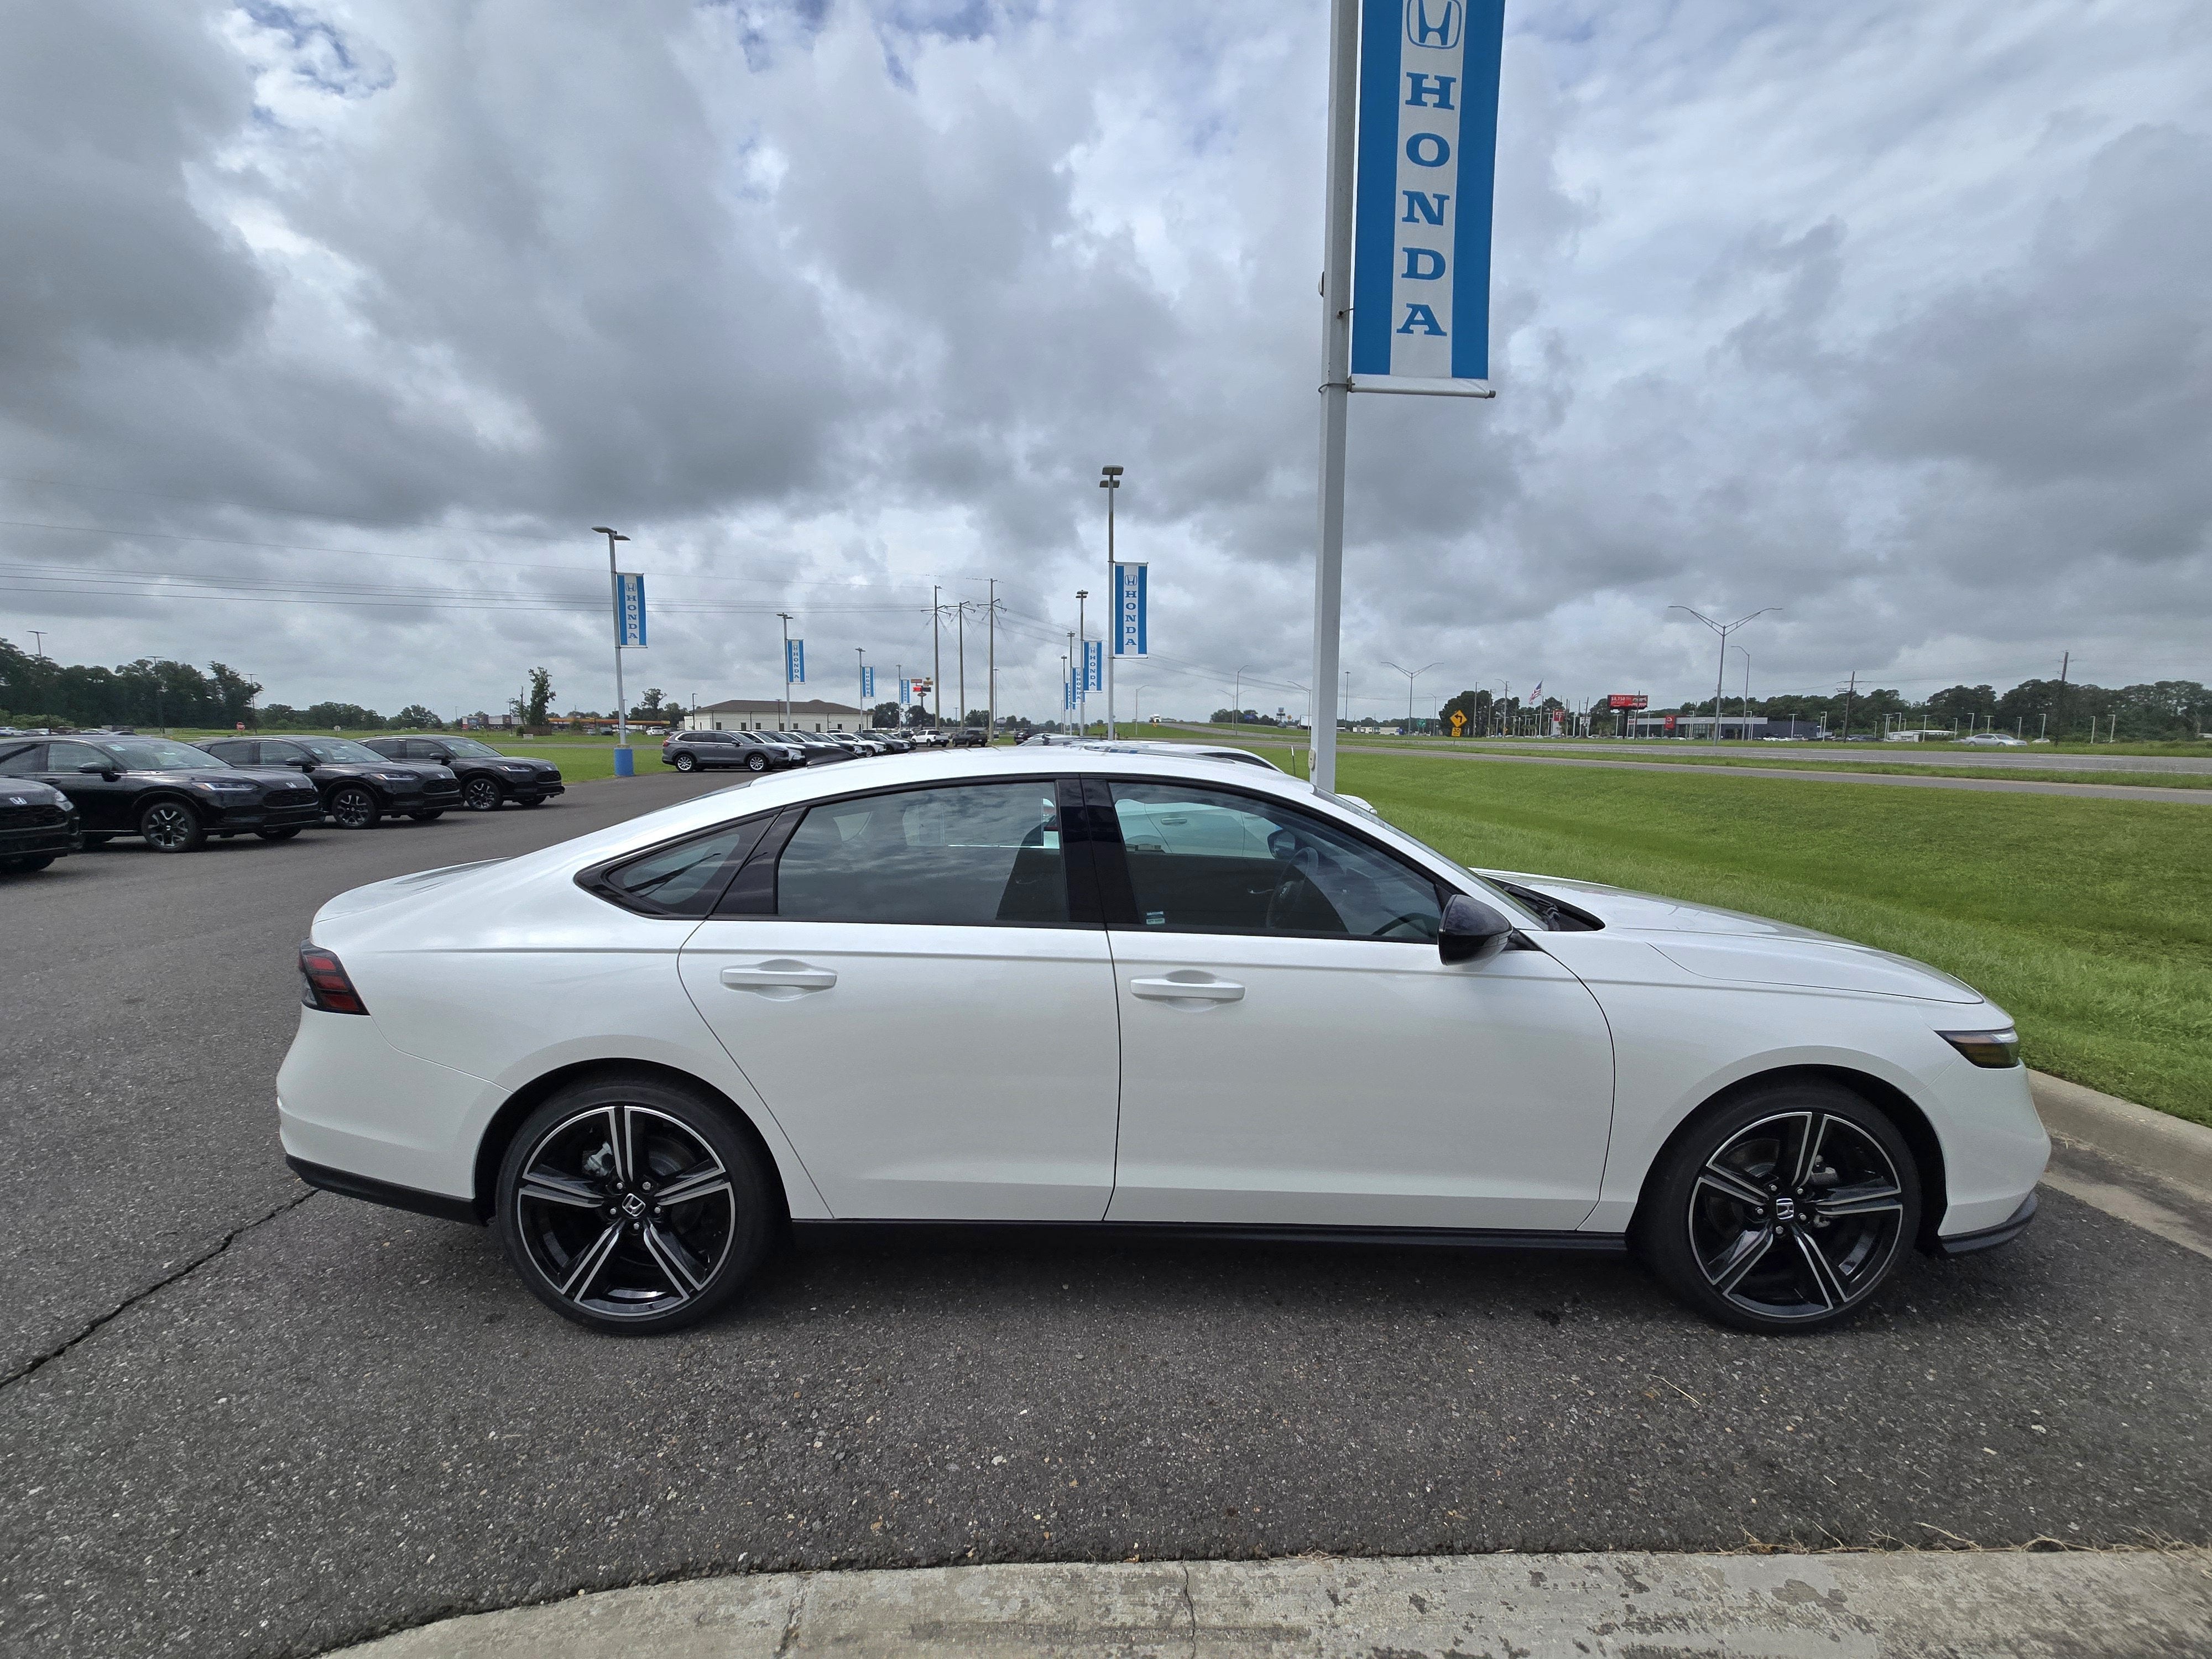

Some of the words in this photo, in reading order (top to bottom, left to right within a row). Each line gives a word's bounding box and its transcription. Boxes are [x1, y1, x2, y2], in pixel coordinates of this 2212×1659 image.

[1396, 71, 1457, 337] HONDA
[626, 594, 638, 639] HONDA
[1125, 590, 1137, 645] HONDA
